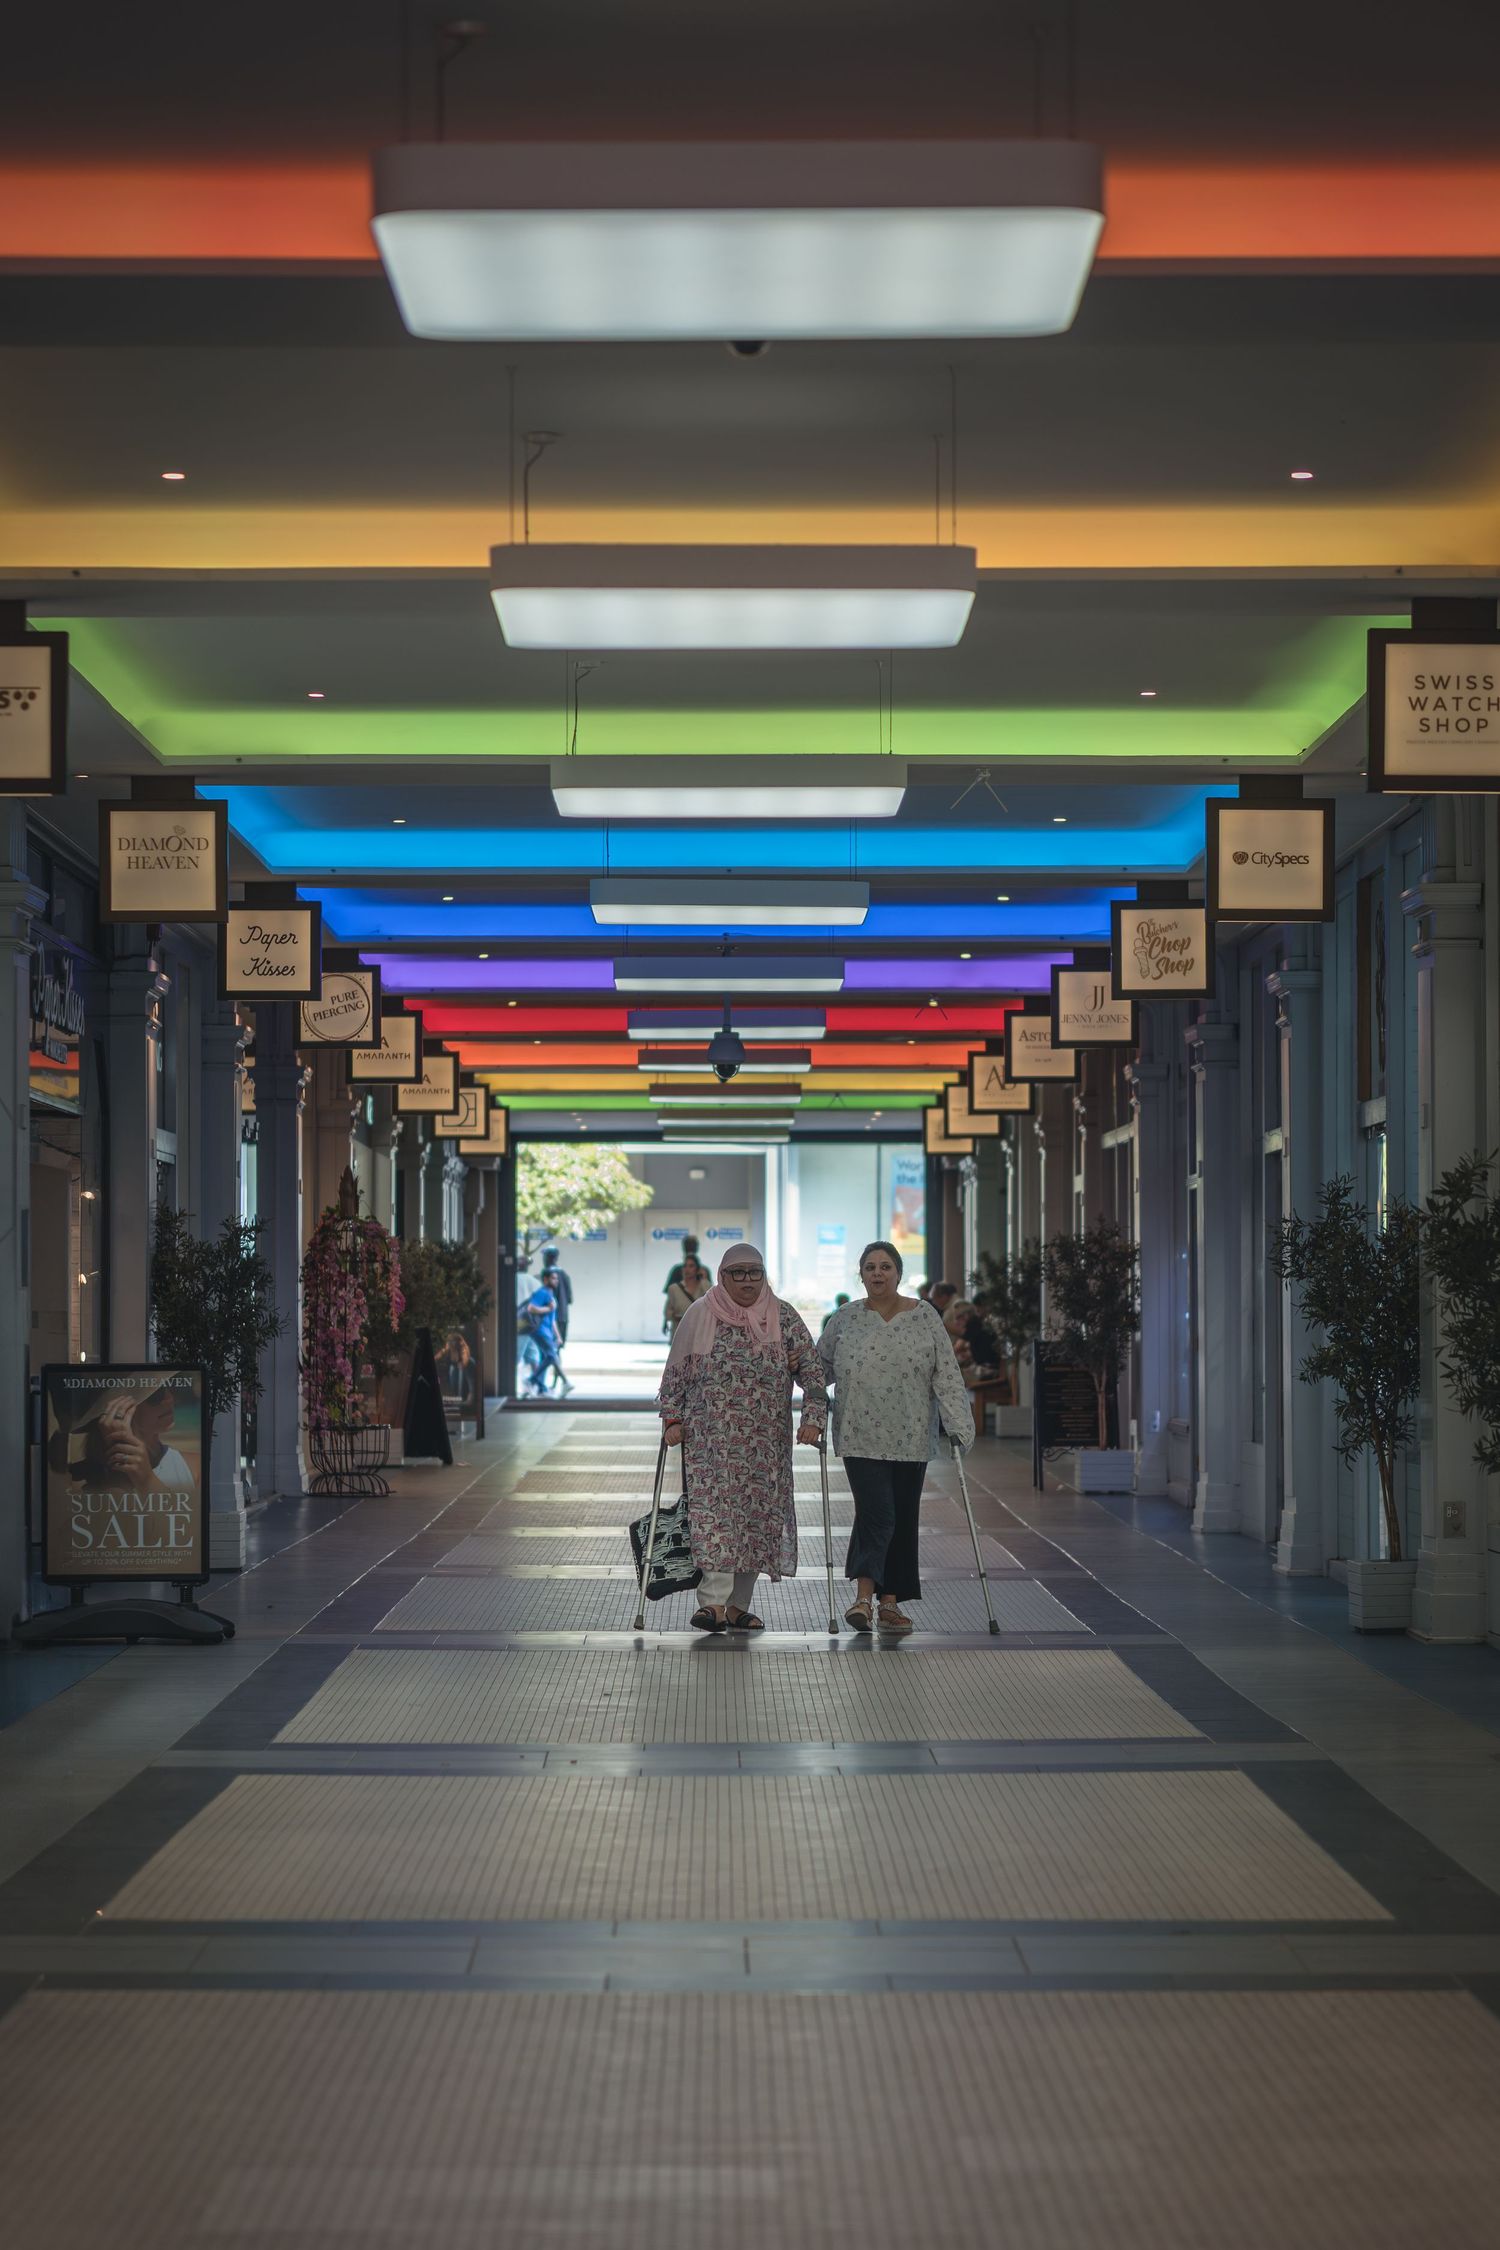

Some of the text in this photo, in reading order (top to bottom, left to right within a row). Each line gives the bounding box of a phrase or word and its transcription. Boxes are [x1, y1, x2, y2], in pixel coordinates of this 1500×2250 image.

[1414, 674, 1494, 691] SWISS
[1408, 696, 1500, 712] WATCH
[1419, 717, 1489, 733] SHOP
[117, 835, 210, 852] DIAMOND
[127, 856, 200, 870] HEAVEN
[1251, 851, 1310, 868] CitySpecs
[240, 925, 299, 953] Paper
[1148, 936, 1192, 960] Chop
[242, 957, 296, 976] Kisses
[1151, 956, 1195, 980] Shop
[330, 989, 360, 1005] PURE
[312, 1000, 365, 1022] PIERCING
[1061, 1014, 1129, 1024] JENNY JONES
[356, 1052, 411, 1060] AMARANTH
[70, 1378, 192, 1389] DIAMOND HEAVEN
[71, 1492, 192, 1513] SUMMER
[71, 1513, 193, 1549] SALE
